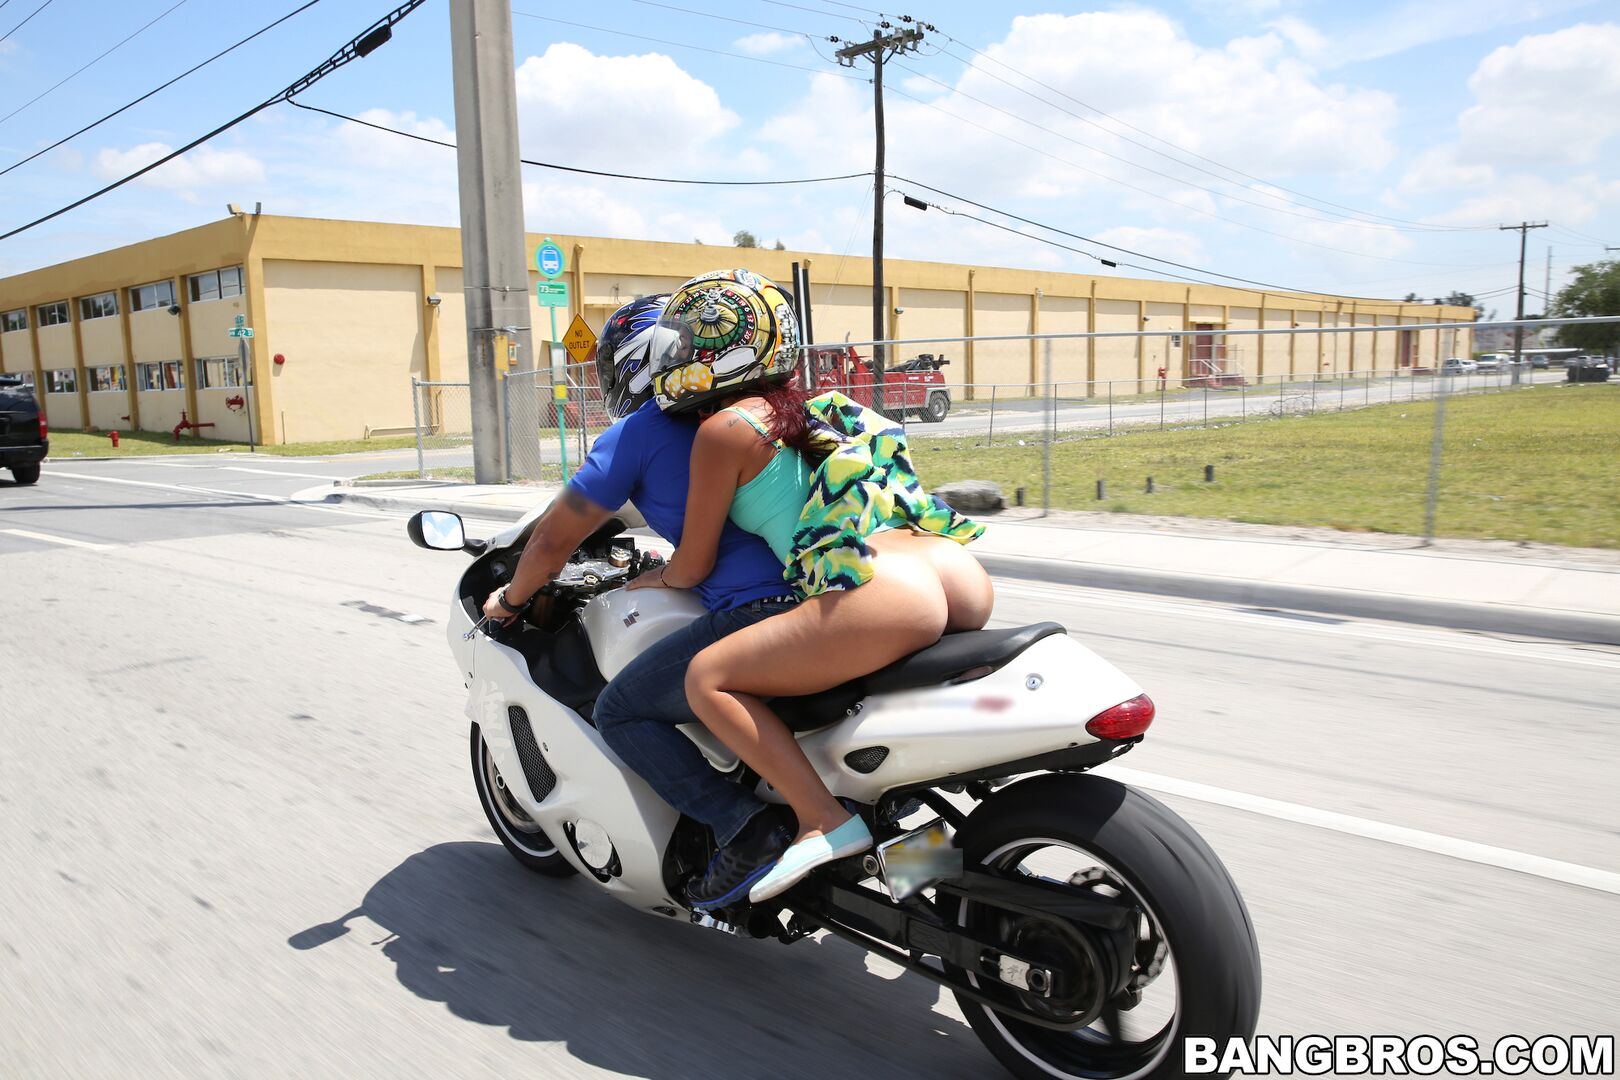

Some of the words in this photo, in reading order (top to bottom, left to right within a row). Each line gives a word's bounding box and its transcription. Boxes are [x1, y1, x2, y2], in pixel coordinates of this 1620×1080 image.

[540, 285, 549, 293] 73
[575, 329, 582, 337] NO
[568, 340, 590, 349] OUTLET
